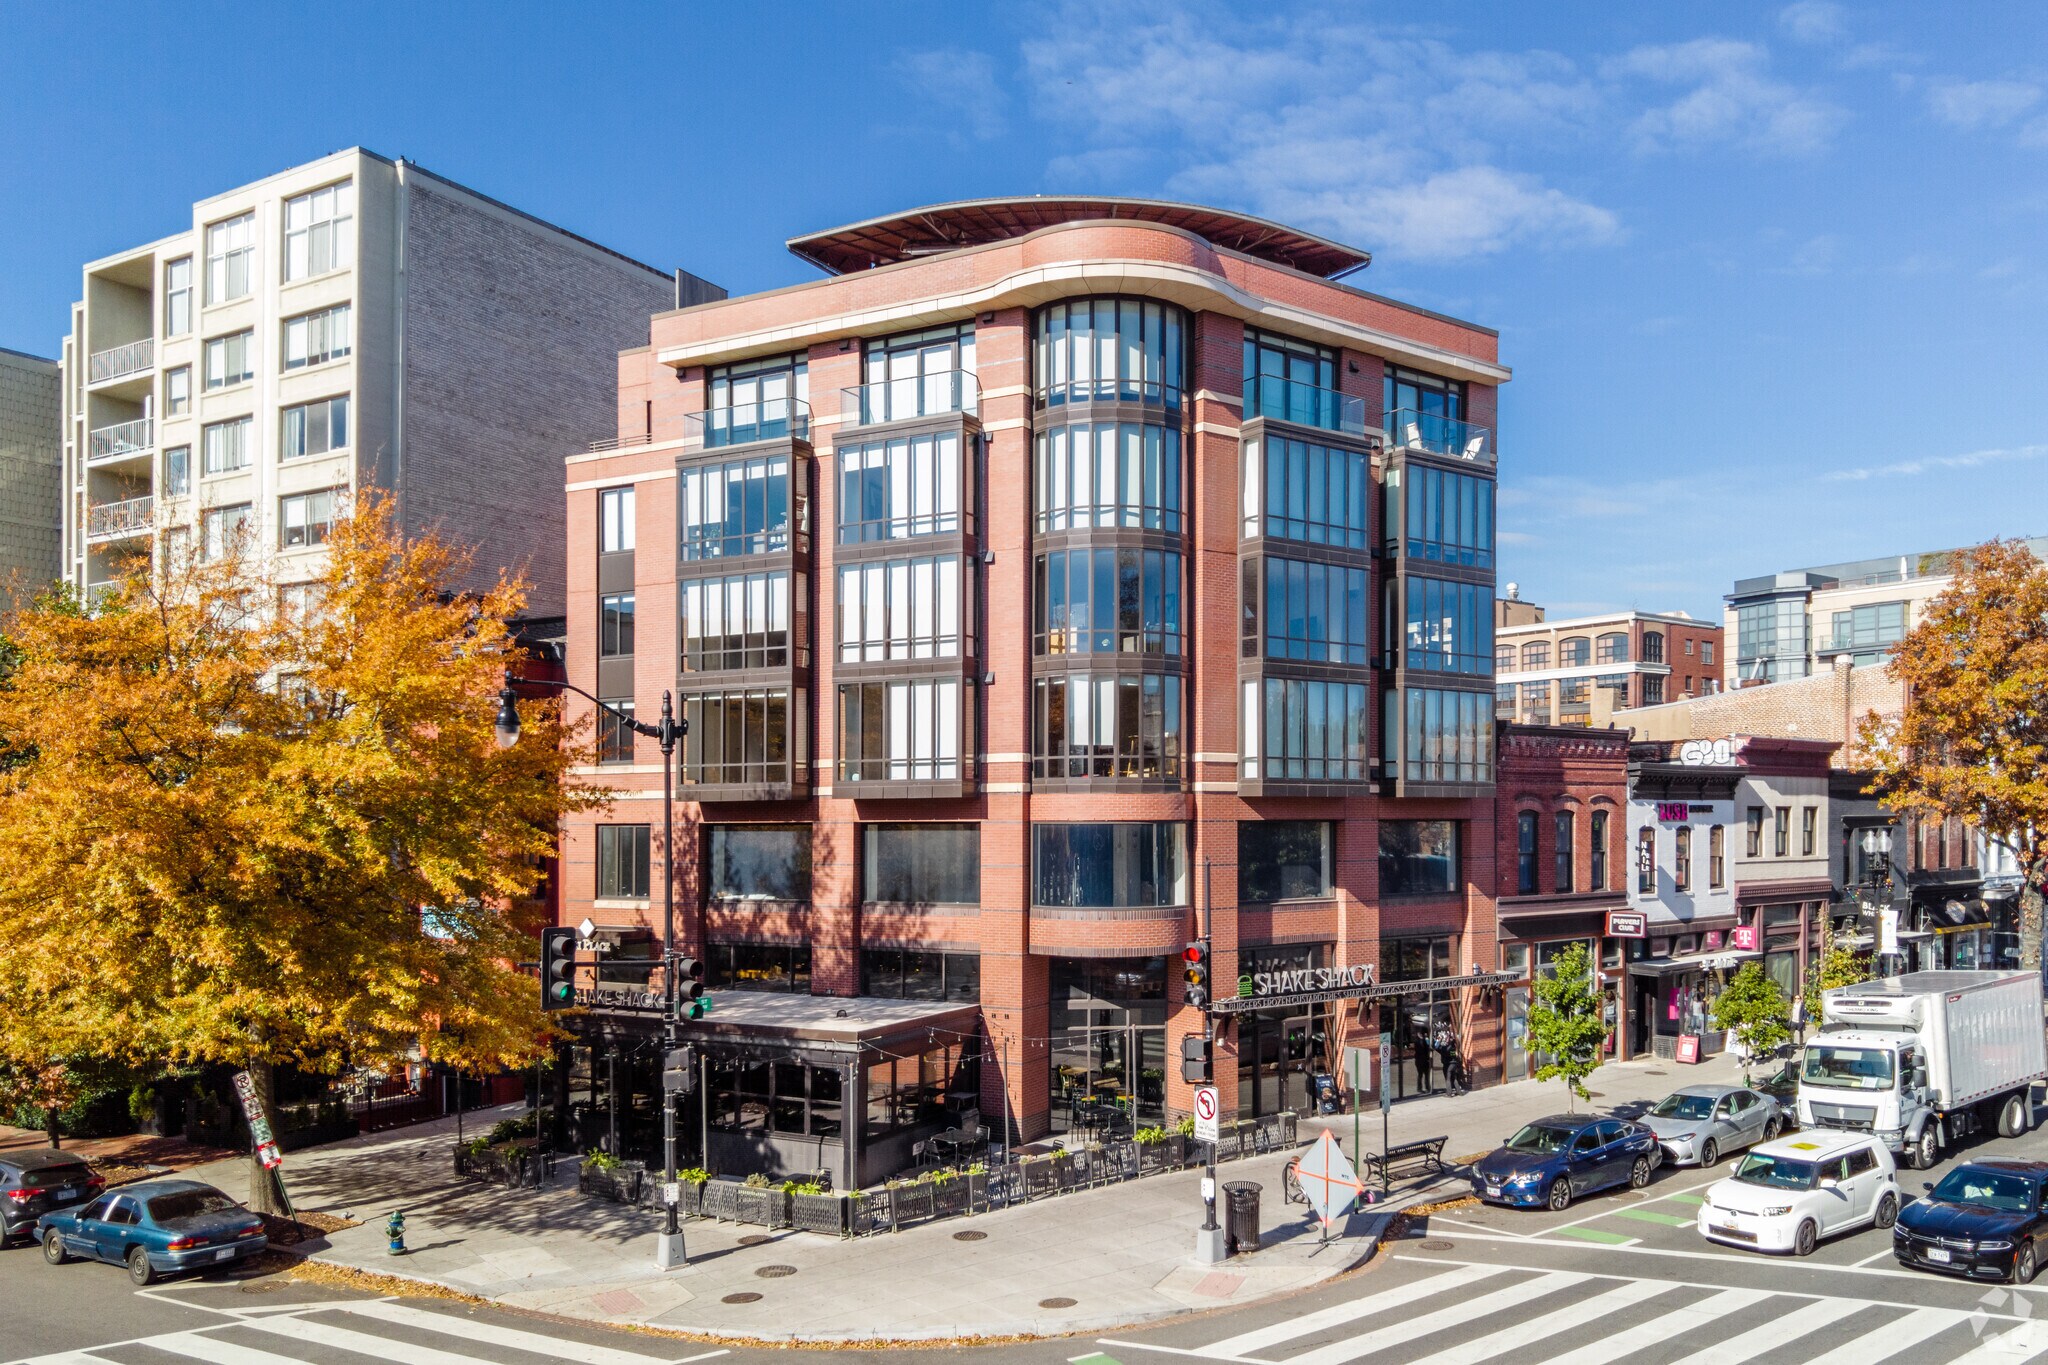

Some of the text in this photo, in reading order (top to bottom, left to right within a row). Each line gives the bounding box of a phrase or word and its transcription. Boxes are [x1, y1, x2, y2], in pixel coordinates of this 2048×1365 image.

[582, 939, 611, 951] PLACE
[1739, 930, 1752, 945] T
[1254, 964, 1375, 995] SHAKE SHACK
[574, 989, 660, 1008] SHAKE SHACK
[1229, 1001, 1262, 1011] BURGERS
[1264, 999, 1291, 1008] FROZEN
[1291, 995, 1322, 1005] CUSTARD
